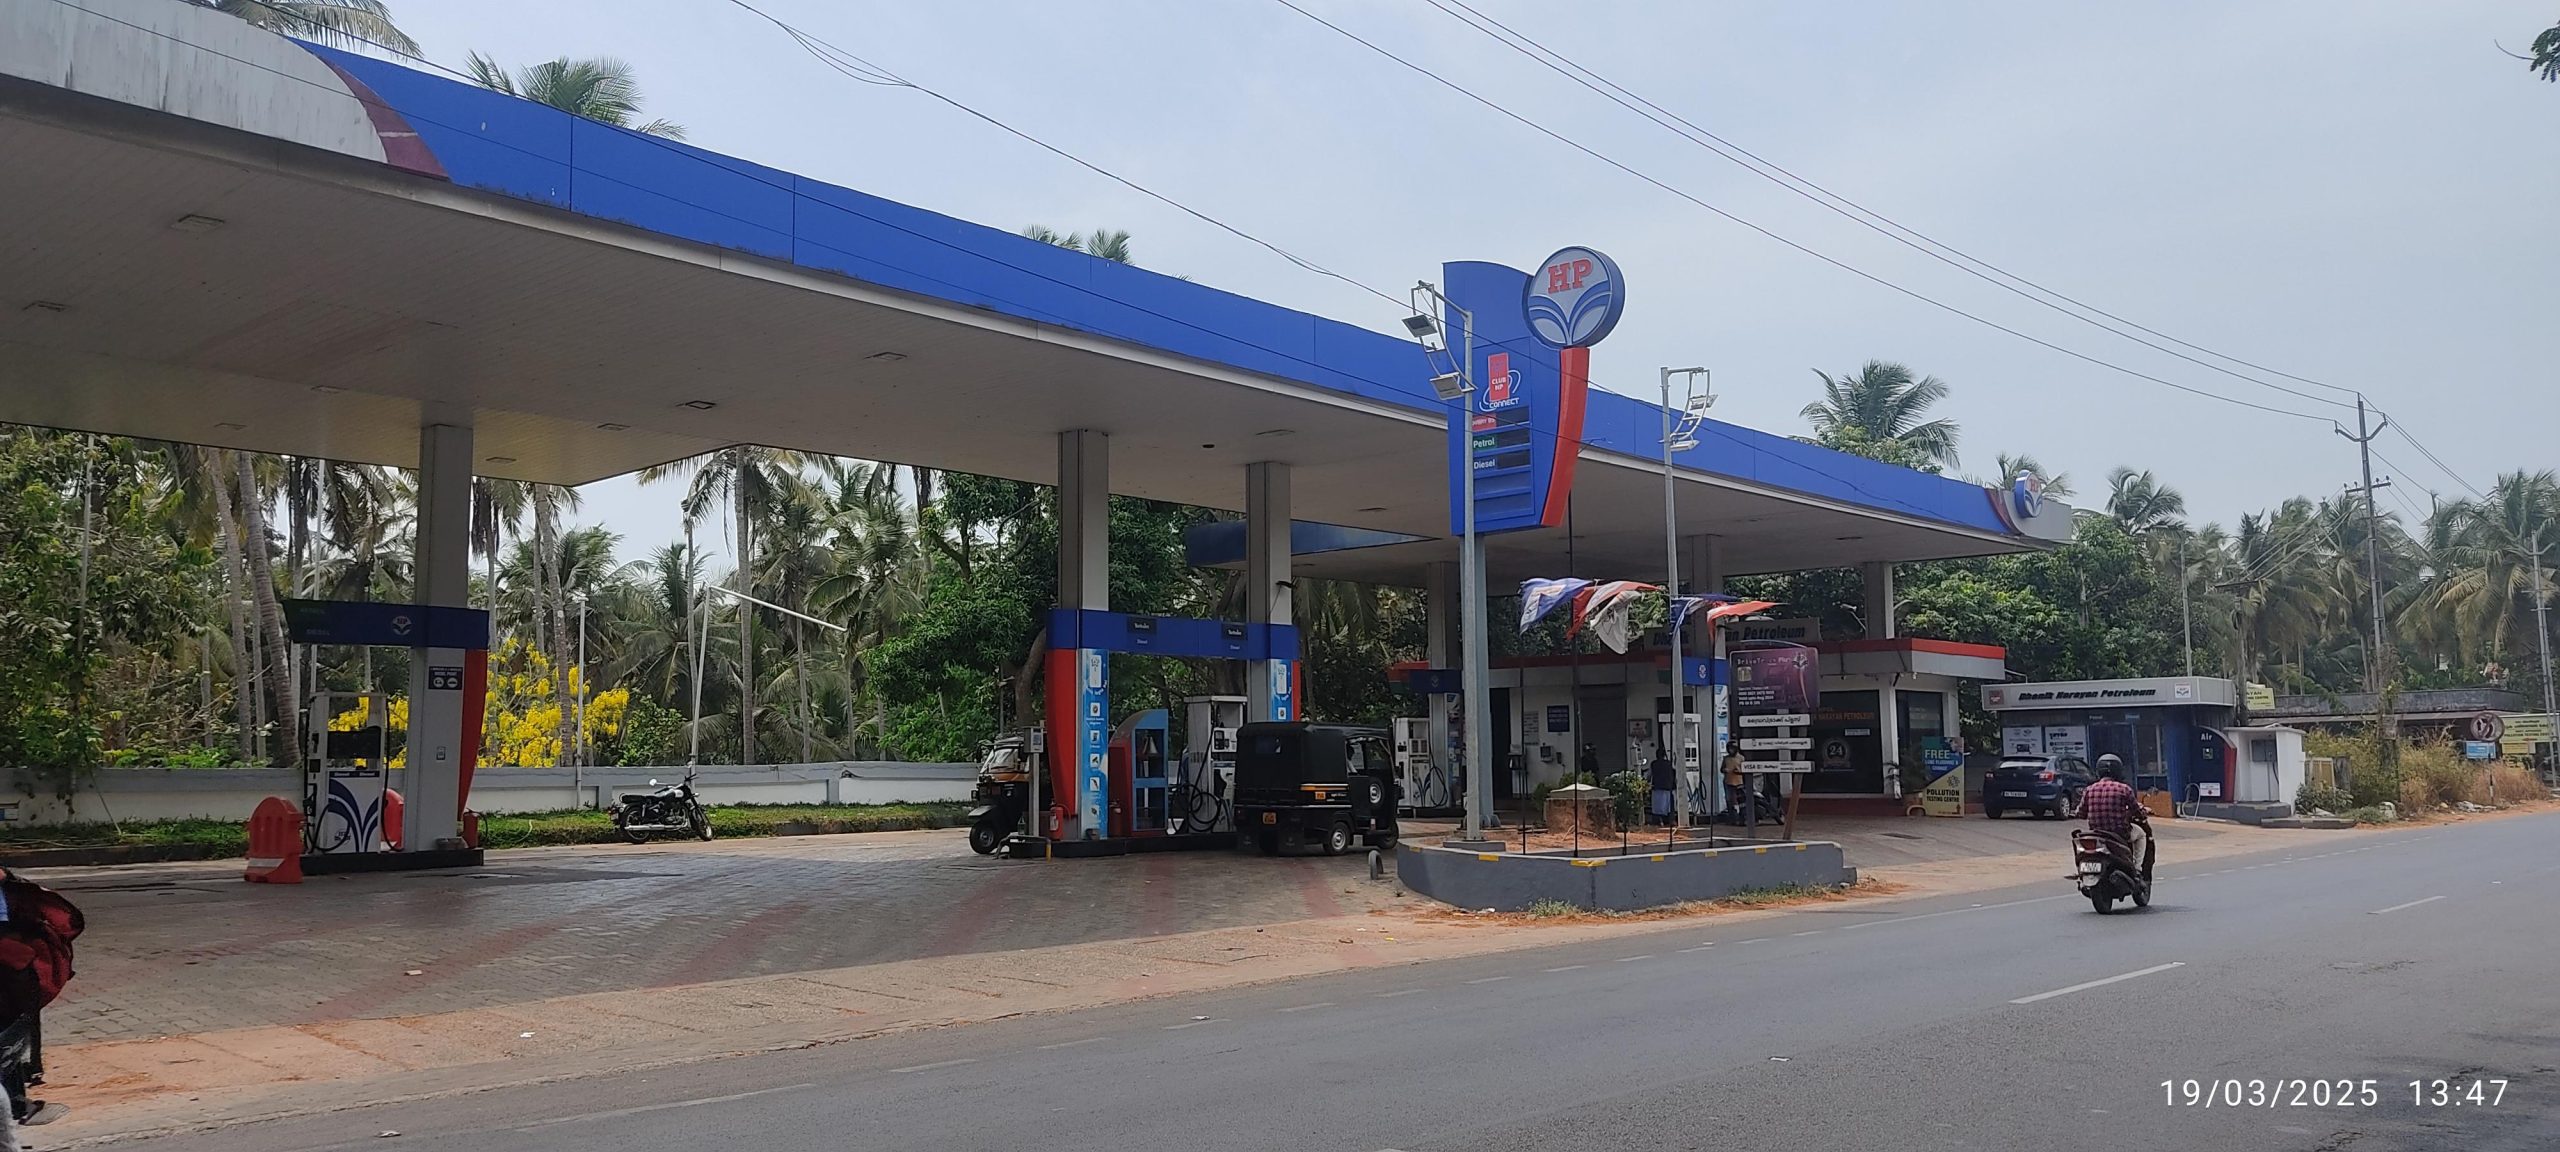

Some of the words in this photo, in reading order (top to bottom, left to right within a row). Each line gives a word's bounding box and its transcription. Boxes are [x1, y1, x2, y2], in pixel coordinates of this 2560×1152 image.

[1547, 257, 1593, 295] HP
[1491, 377, 1507, 386] CLUB
[1489, 397, 1520, 409] CONNECT
[1473, 438, 1495, 449] Petrol
[1473, 459, 1496, 470] Diesel
[1743, 626, 1806, 642] Petroleum
[2100, 688, 2157, 698] Petroleum
[1829, 745, 1844, 756] 24
[1925, 749, 1951, 760] FREE
[1926, 788, 1960, 797] POLLUTION
